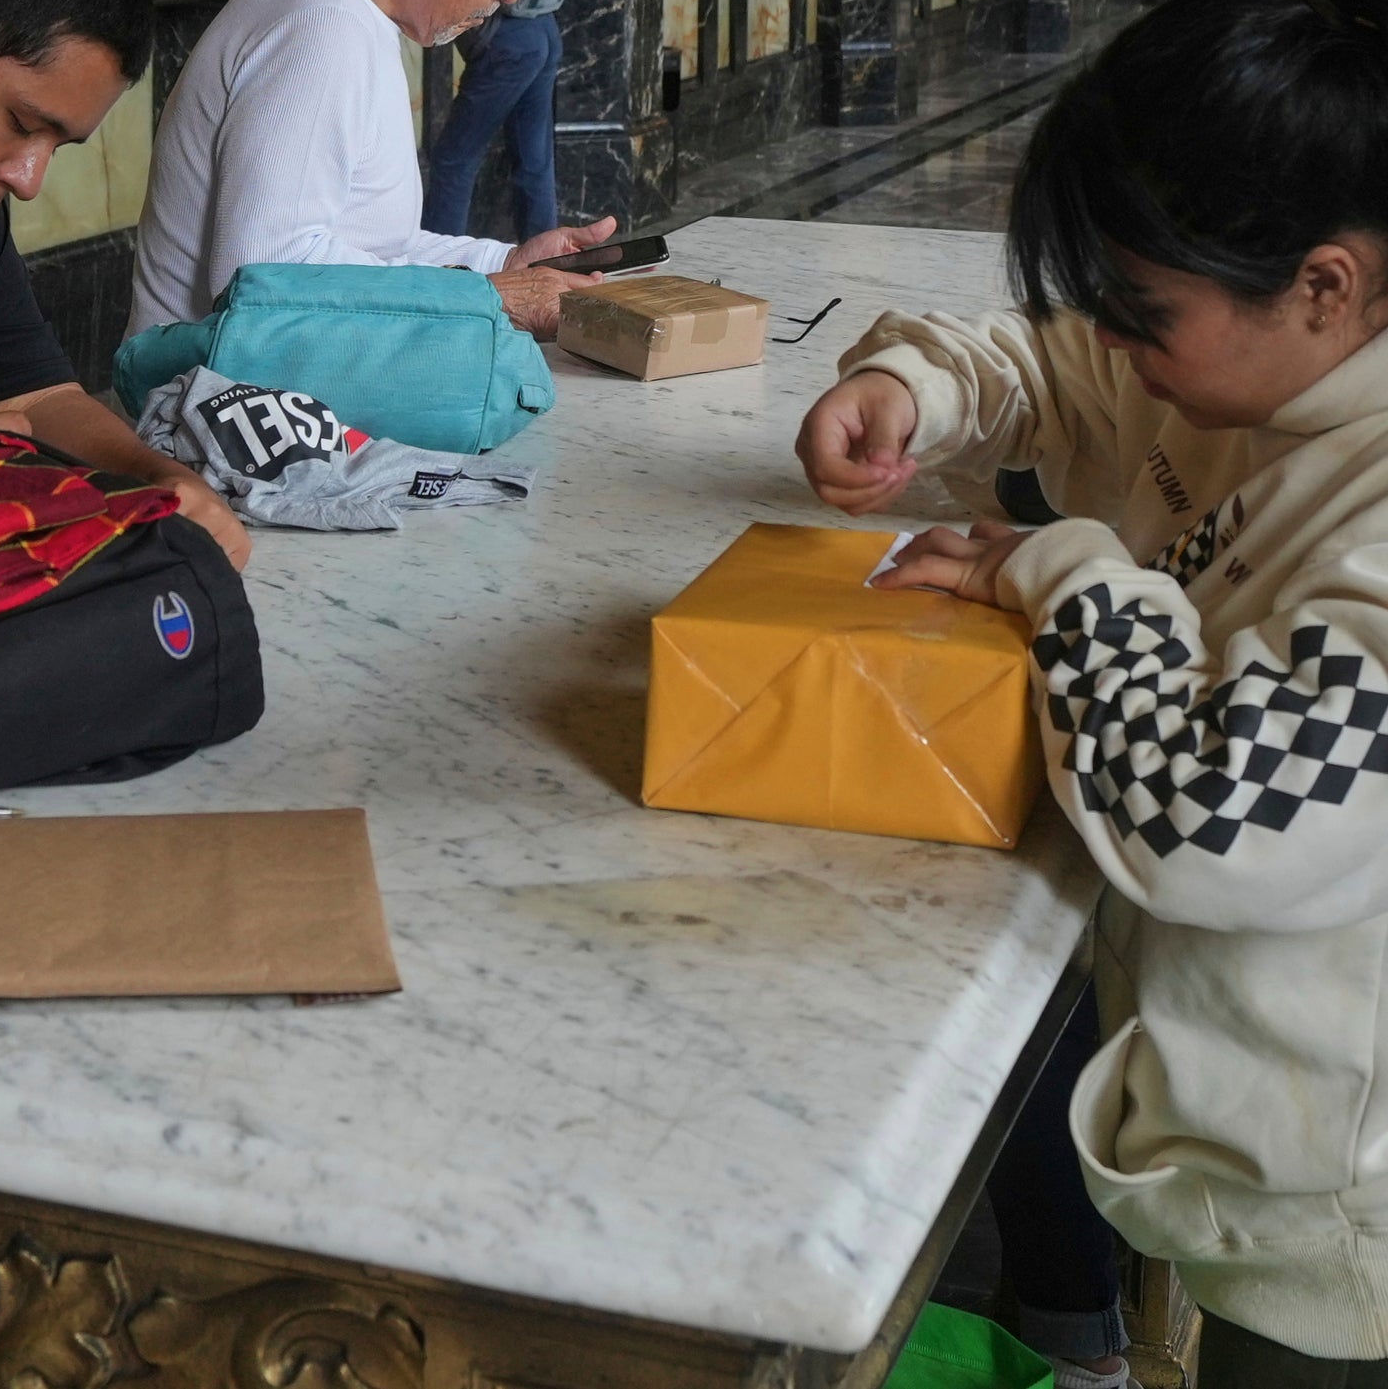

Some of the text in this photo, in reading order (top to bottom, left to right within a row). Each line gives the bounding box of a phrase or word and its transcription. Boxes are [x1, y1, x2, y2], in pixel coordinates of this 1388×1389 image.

[210, 387, 259, 409] LIVING
[216, 391, 342, 468] ESEL
[417, 479, 450, 496] ESEL
[1148, 443, 1193, 515] UTUMN
